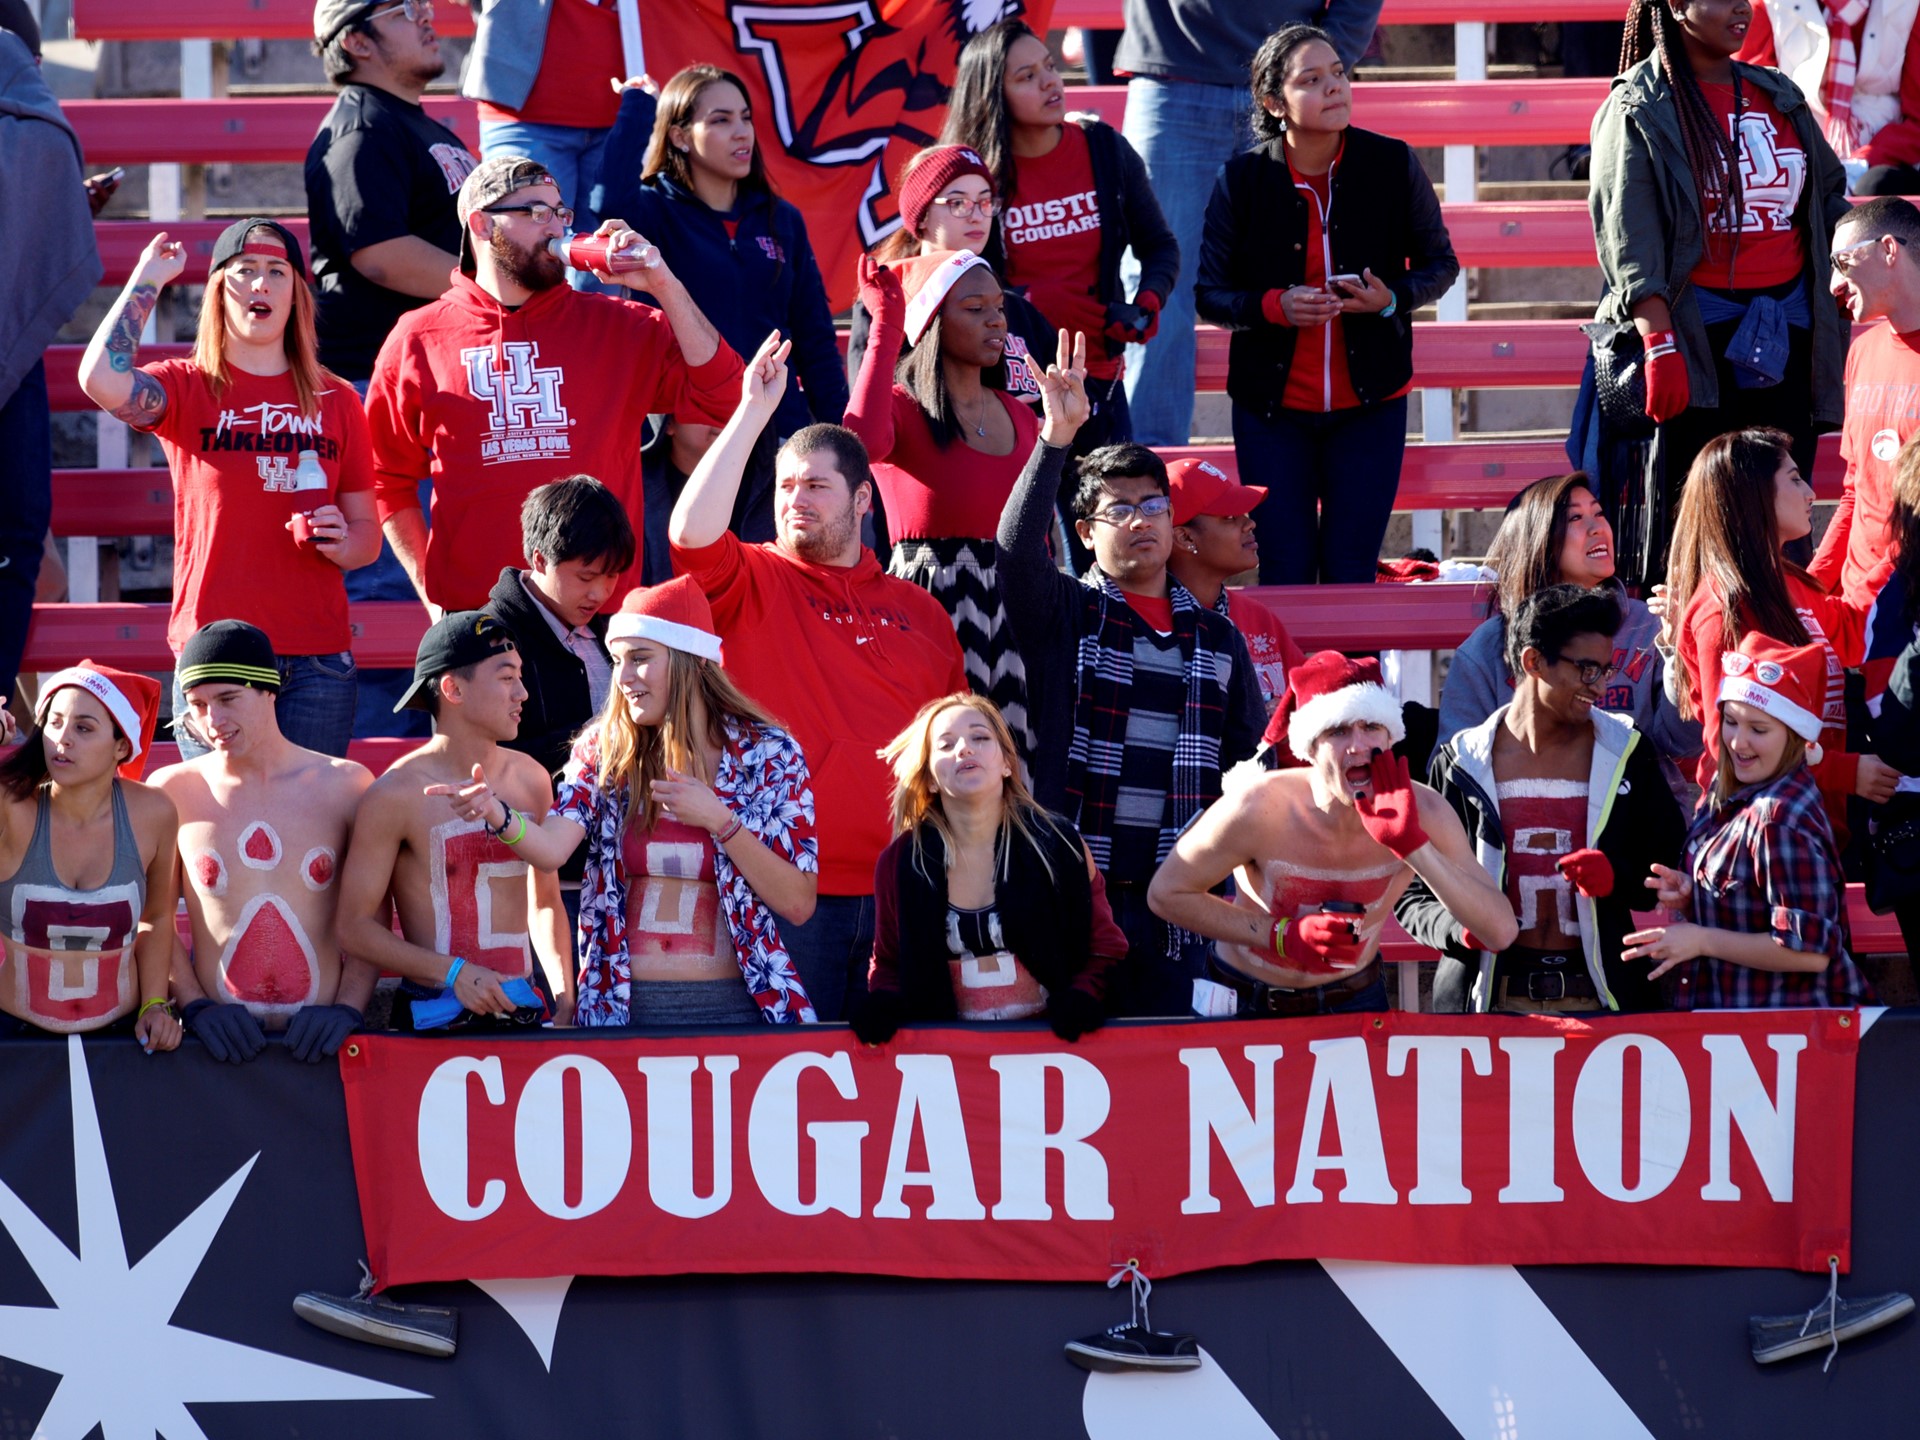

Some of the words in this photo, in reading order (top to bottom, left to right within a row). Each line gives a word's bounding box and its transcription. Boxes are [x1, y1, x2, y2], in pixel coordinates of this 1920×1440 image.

[460, 341, 568, 430] UH
[200, 427, 339, 462] TAKEOVER
[481, 441, 500, 457] LAS
[501, 437, 537, 453] VEGAS
[539, 435, 571, 449] BOWL
[256, 455, 297, 493] UH
[418, 1050, 1115, 1222] COUGAR
[1178, 1032, 1808, 1215] NATION
